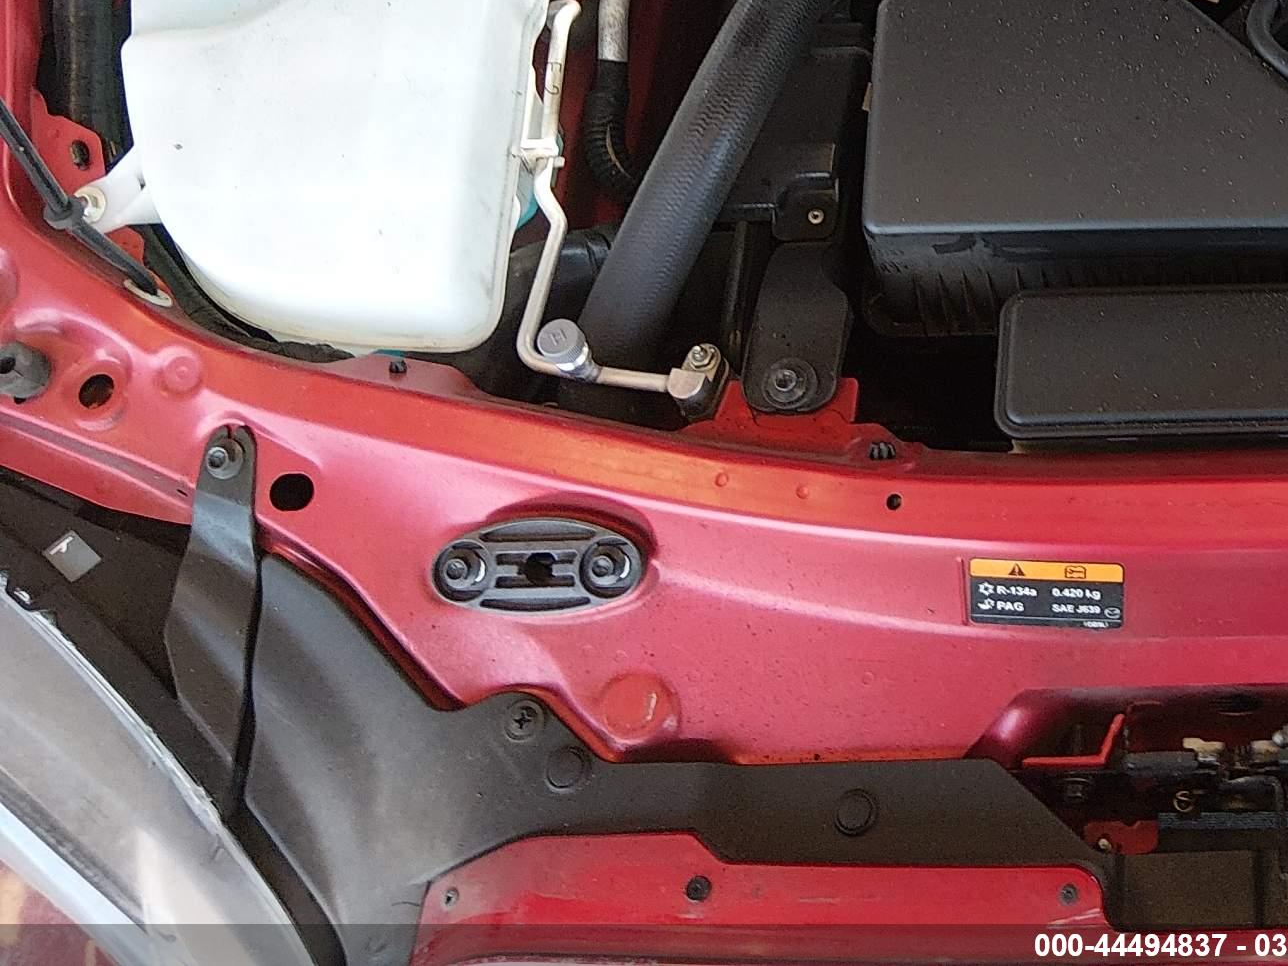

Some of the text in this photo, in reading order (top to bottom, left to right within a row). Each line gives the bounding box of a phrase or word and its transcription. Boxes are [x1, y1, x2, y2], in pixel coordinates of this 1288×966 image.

[996, 586, 1101, 601] R-134a 0.420 kg
[996, 601, 1101, 615] PAG SAE J639
